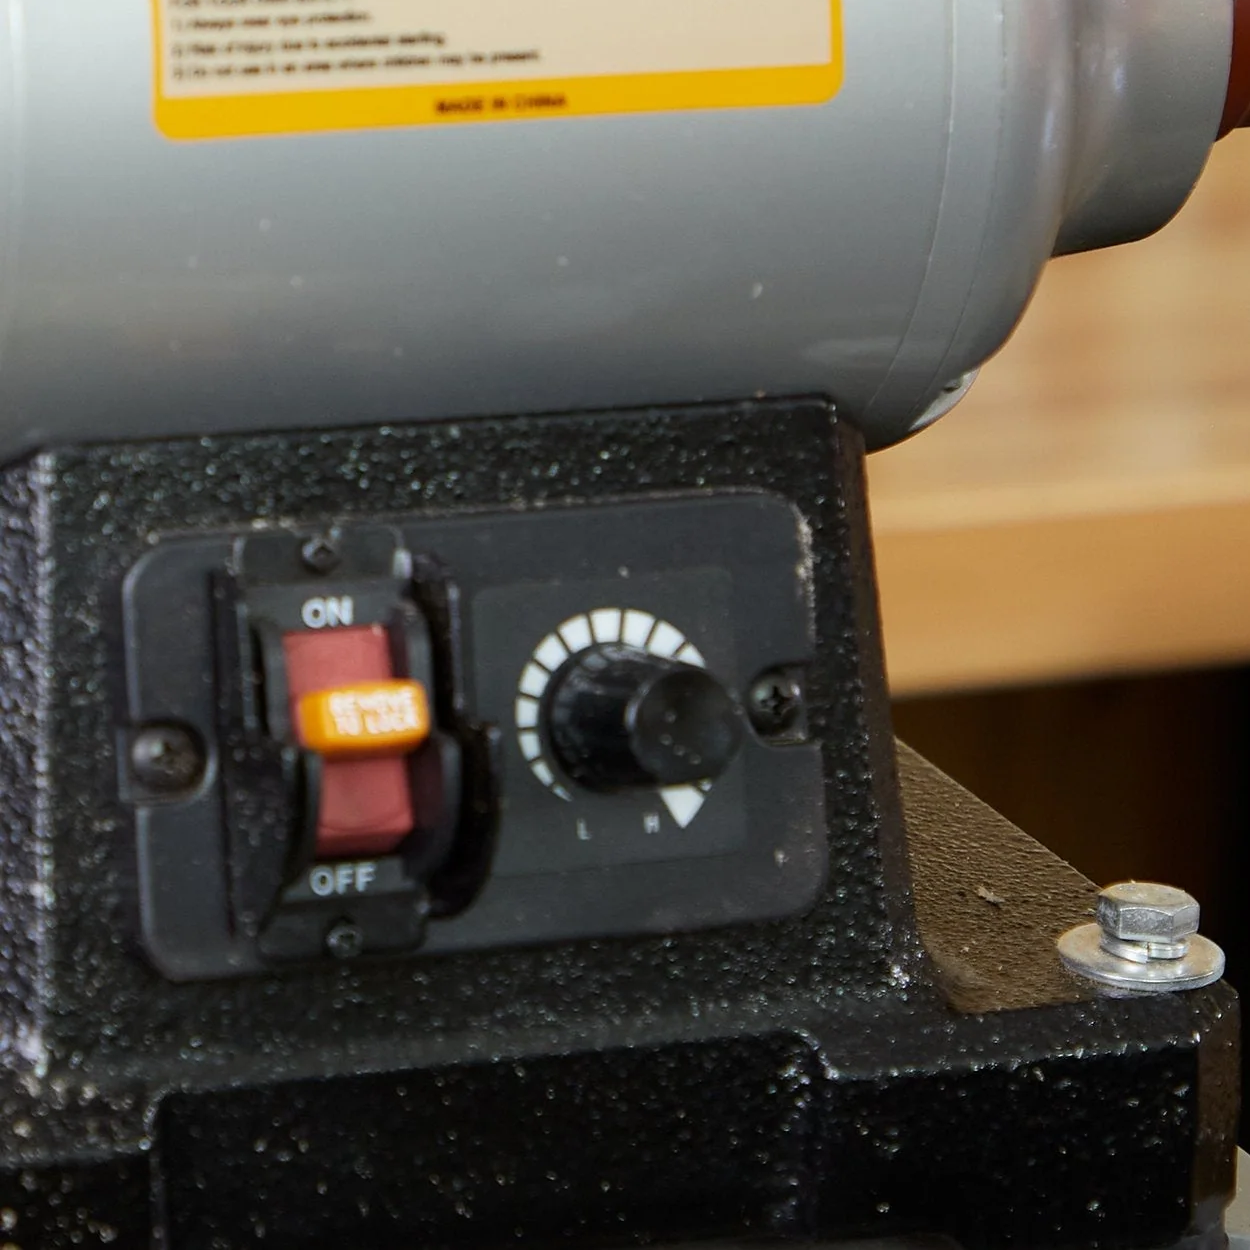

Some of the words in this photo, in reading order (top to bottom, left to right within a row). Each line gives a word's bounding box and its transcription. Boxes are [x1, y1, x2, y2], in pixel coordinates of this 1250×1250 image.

[302, 596, 353, 629] ON
[577, 818, 592, 840] L
[643, 812, 660, 834] H
[309, 862, 376, 896] OFF
